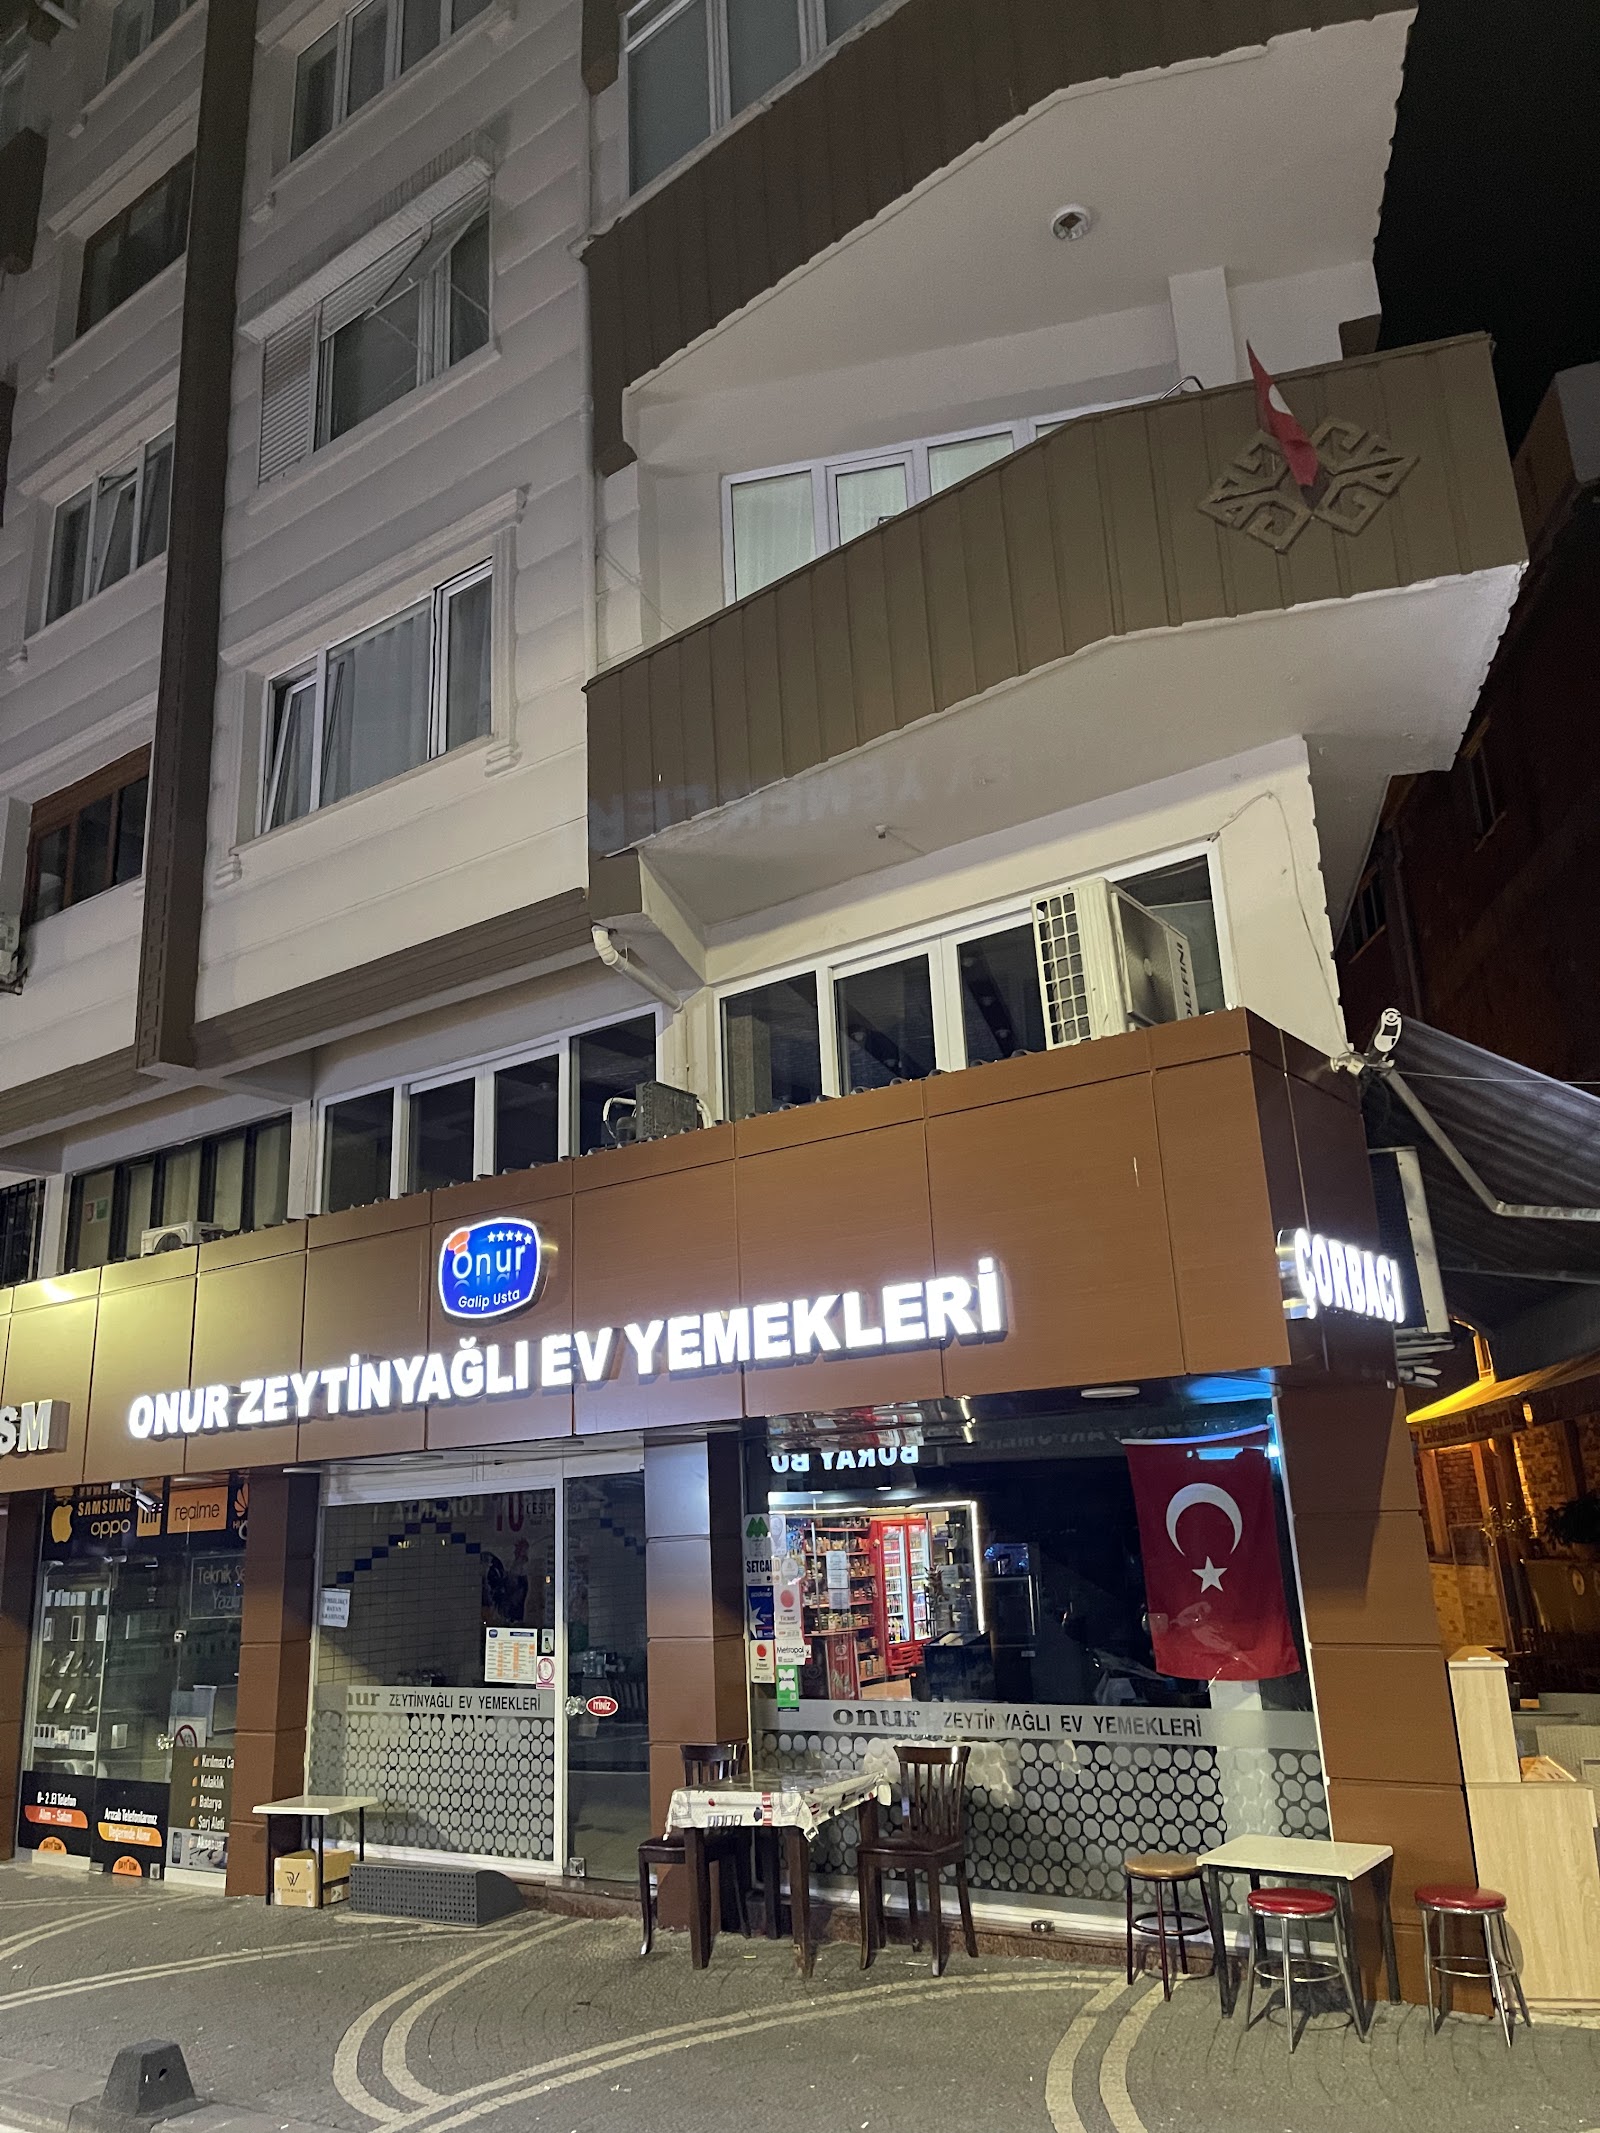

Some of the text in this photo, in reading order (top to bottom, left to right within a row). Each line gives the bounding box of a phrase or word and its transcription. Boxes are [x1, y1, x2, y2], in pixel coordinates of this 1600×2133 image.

[1295, 1227, 1406, 1323] ÇORBACI
[458, 1289, 520, 1311] Galip Usta
[129, 1256, 1003, 1439] ONUR ZEYTİNYAĞLI EV YEMEKLERİ
[77, 1496, 132, 1516] SAMSUNG
[174, 1502, 220, 1521] realme
[90, 1519, 131, 1539] oppo
[388, 1691, 454, 1709] ZEYTİNYAĞLI
[458, 1695, 473, 1709] EV
[478, 1693, 541, 1711] YEMEKLERİ
[832, 1707, 921, 1728] onur
[1060, 1714, 1083, 1732] EV
[1092, 1713, 1202, 1738] YEMEKLERİ
[199, 1794, 223, 1812] Batarya
[197, 1834, 225, 1851] Aksesuar
